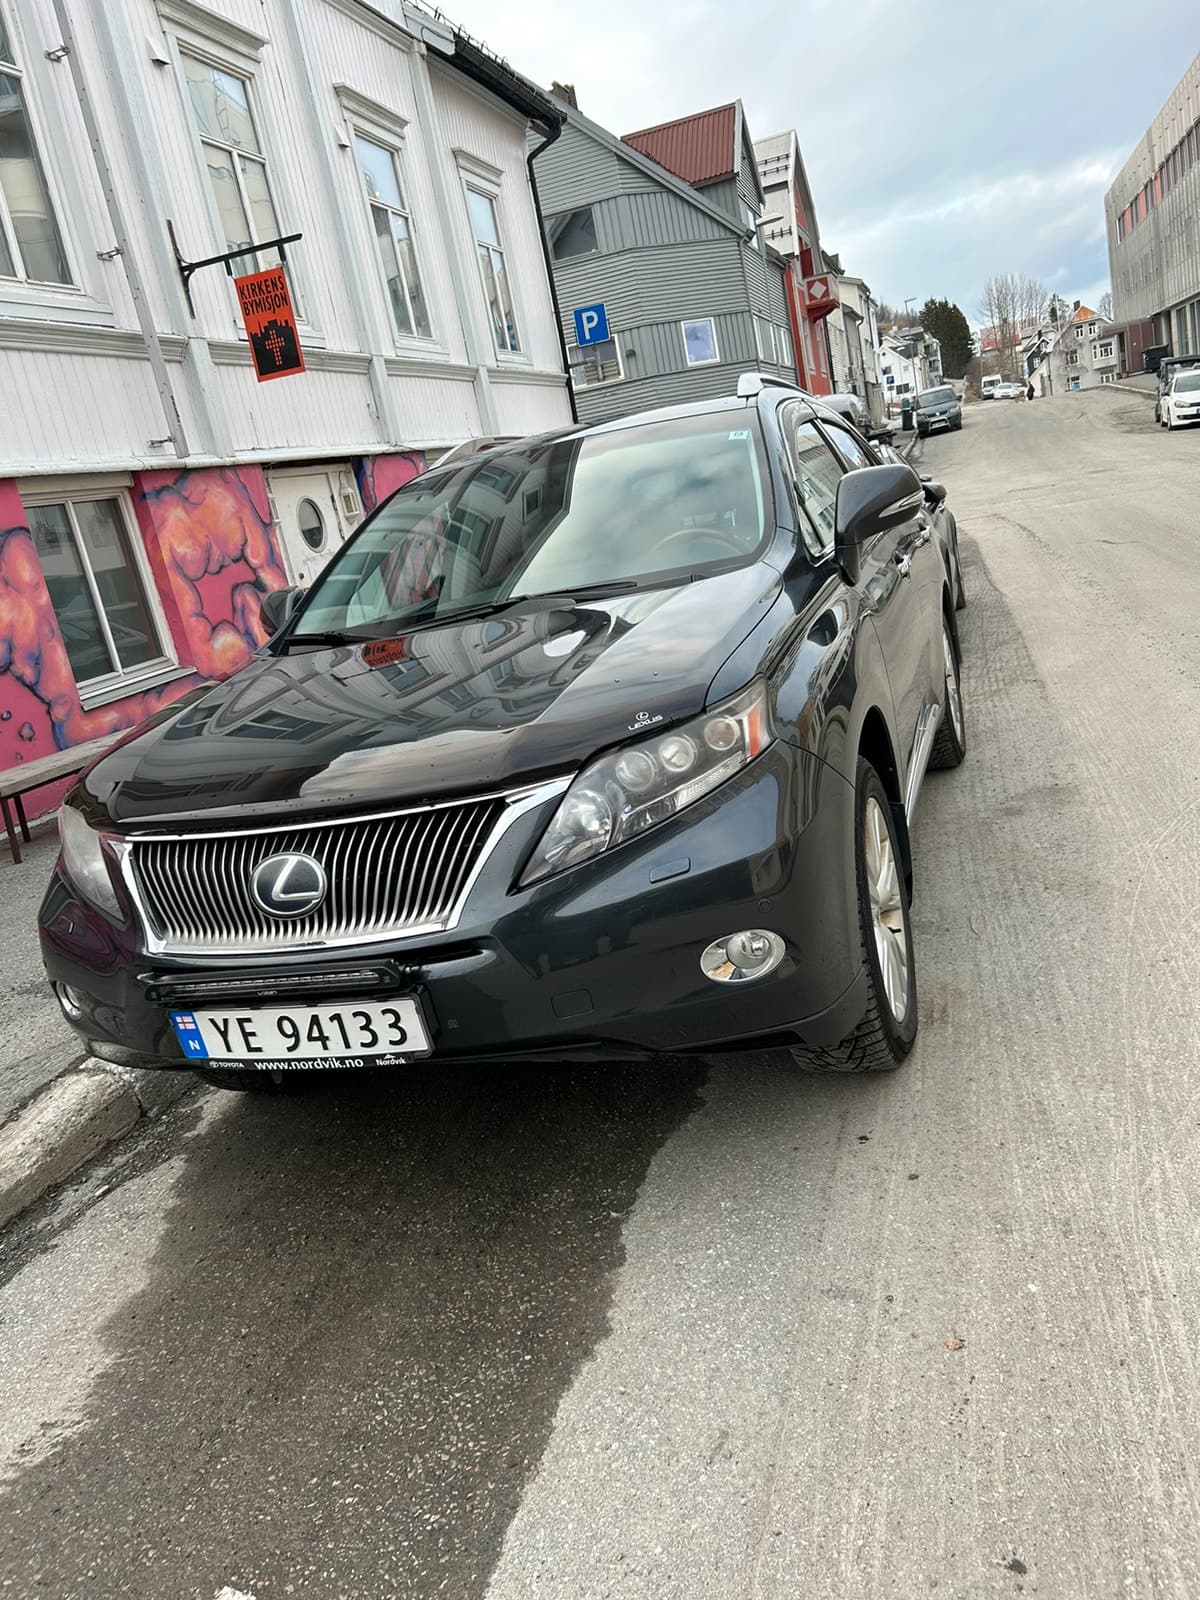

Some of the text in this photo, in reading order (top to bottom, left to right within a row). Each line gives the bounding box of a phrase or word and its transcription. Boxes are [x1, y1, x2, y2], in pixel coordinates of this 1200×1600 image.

[239, 275, 285, 301] KIRKENS
[242, 291, 288, 317] BYMISJON
[581, 311, 599, 340] P
[628, 714, 664, 731] LEXUS
[208, 1008, 408, 1053] YE 94133
[188, 1039, 201, 1050] N
[219, 1056, 407, 1070] TOYOTA www.nordvik.no Nordvik
